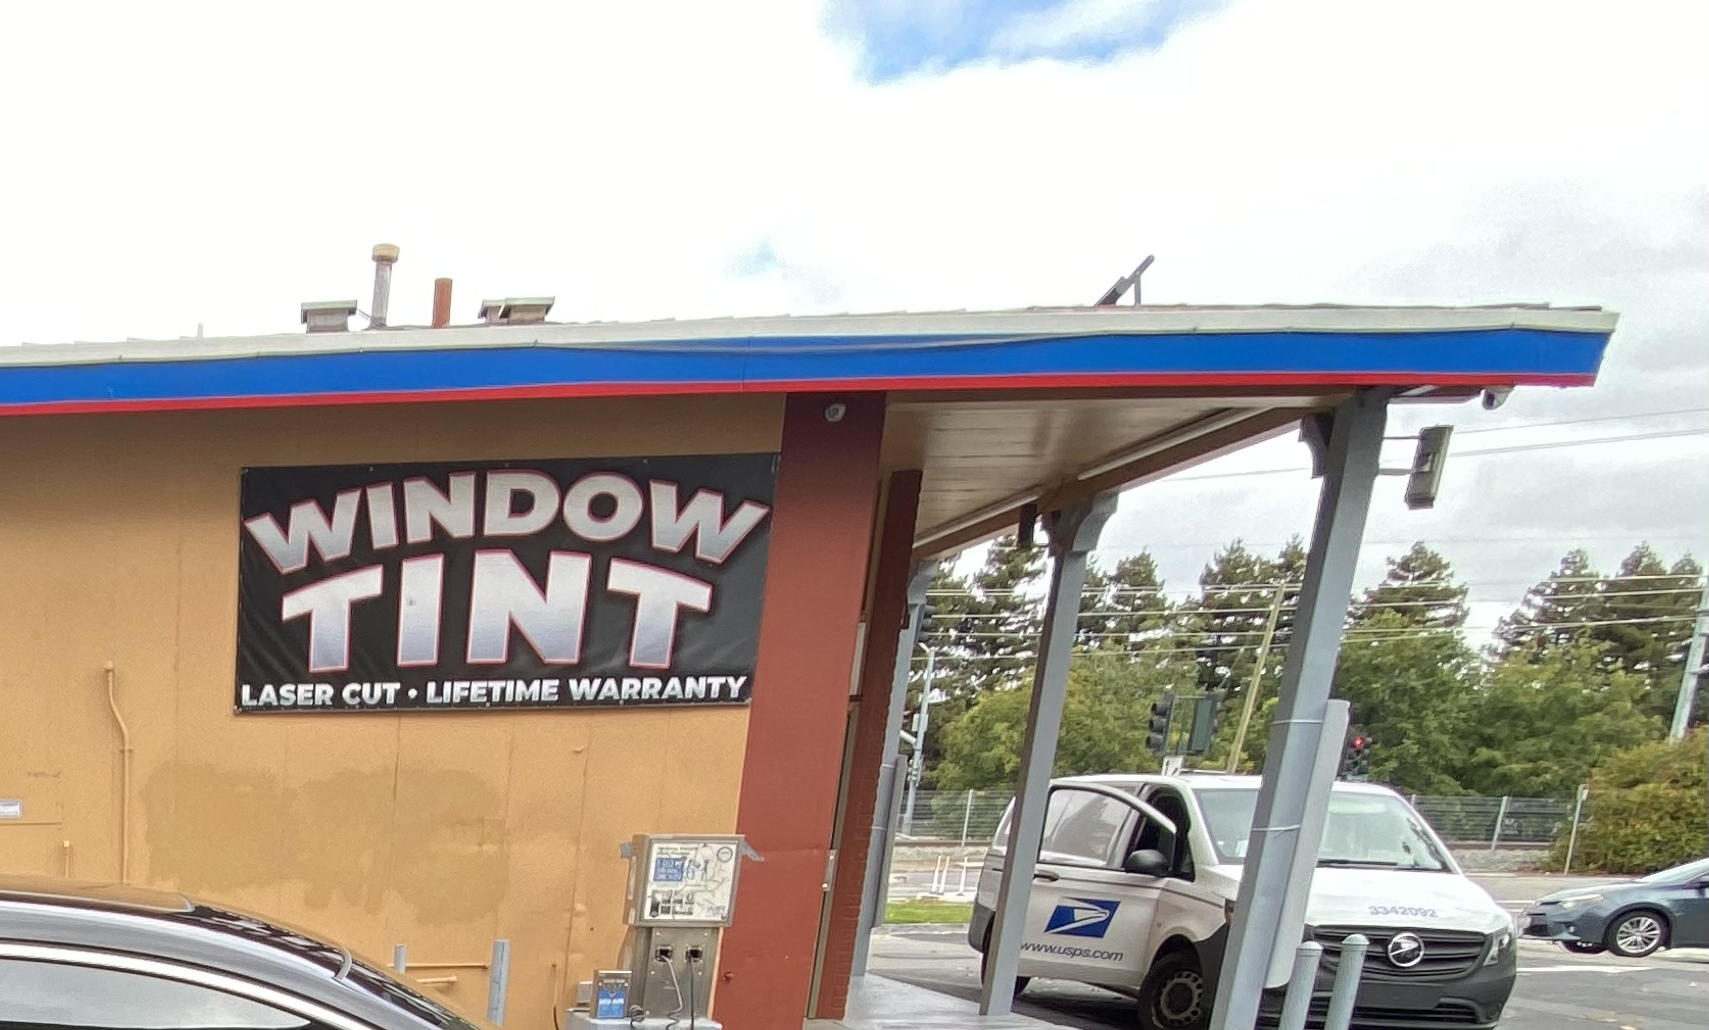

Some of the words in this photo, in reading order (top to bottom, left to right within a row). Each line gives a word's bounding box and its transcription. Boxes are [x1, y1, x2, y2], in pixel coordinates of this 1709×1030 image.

[242, 469, 770, 575] WINDOW
[280, 548, 713, 673] TINT
[241, 683, 335, 706] LASER
[341, 682, 401, 705] CUT
[426, 679, 560, 705] LIFETIME
[568, 676, 747, 701] WARRANTY
[1020, 942, 1124, 962] www.usps.com
